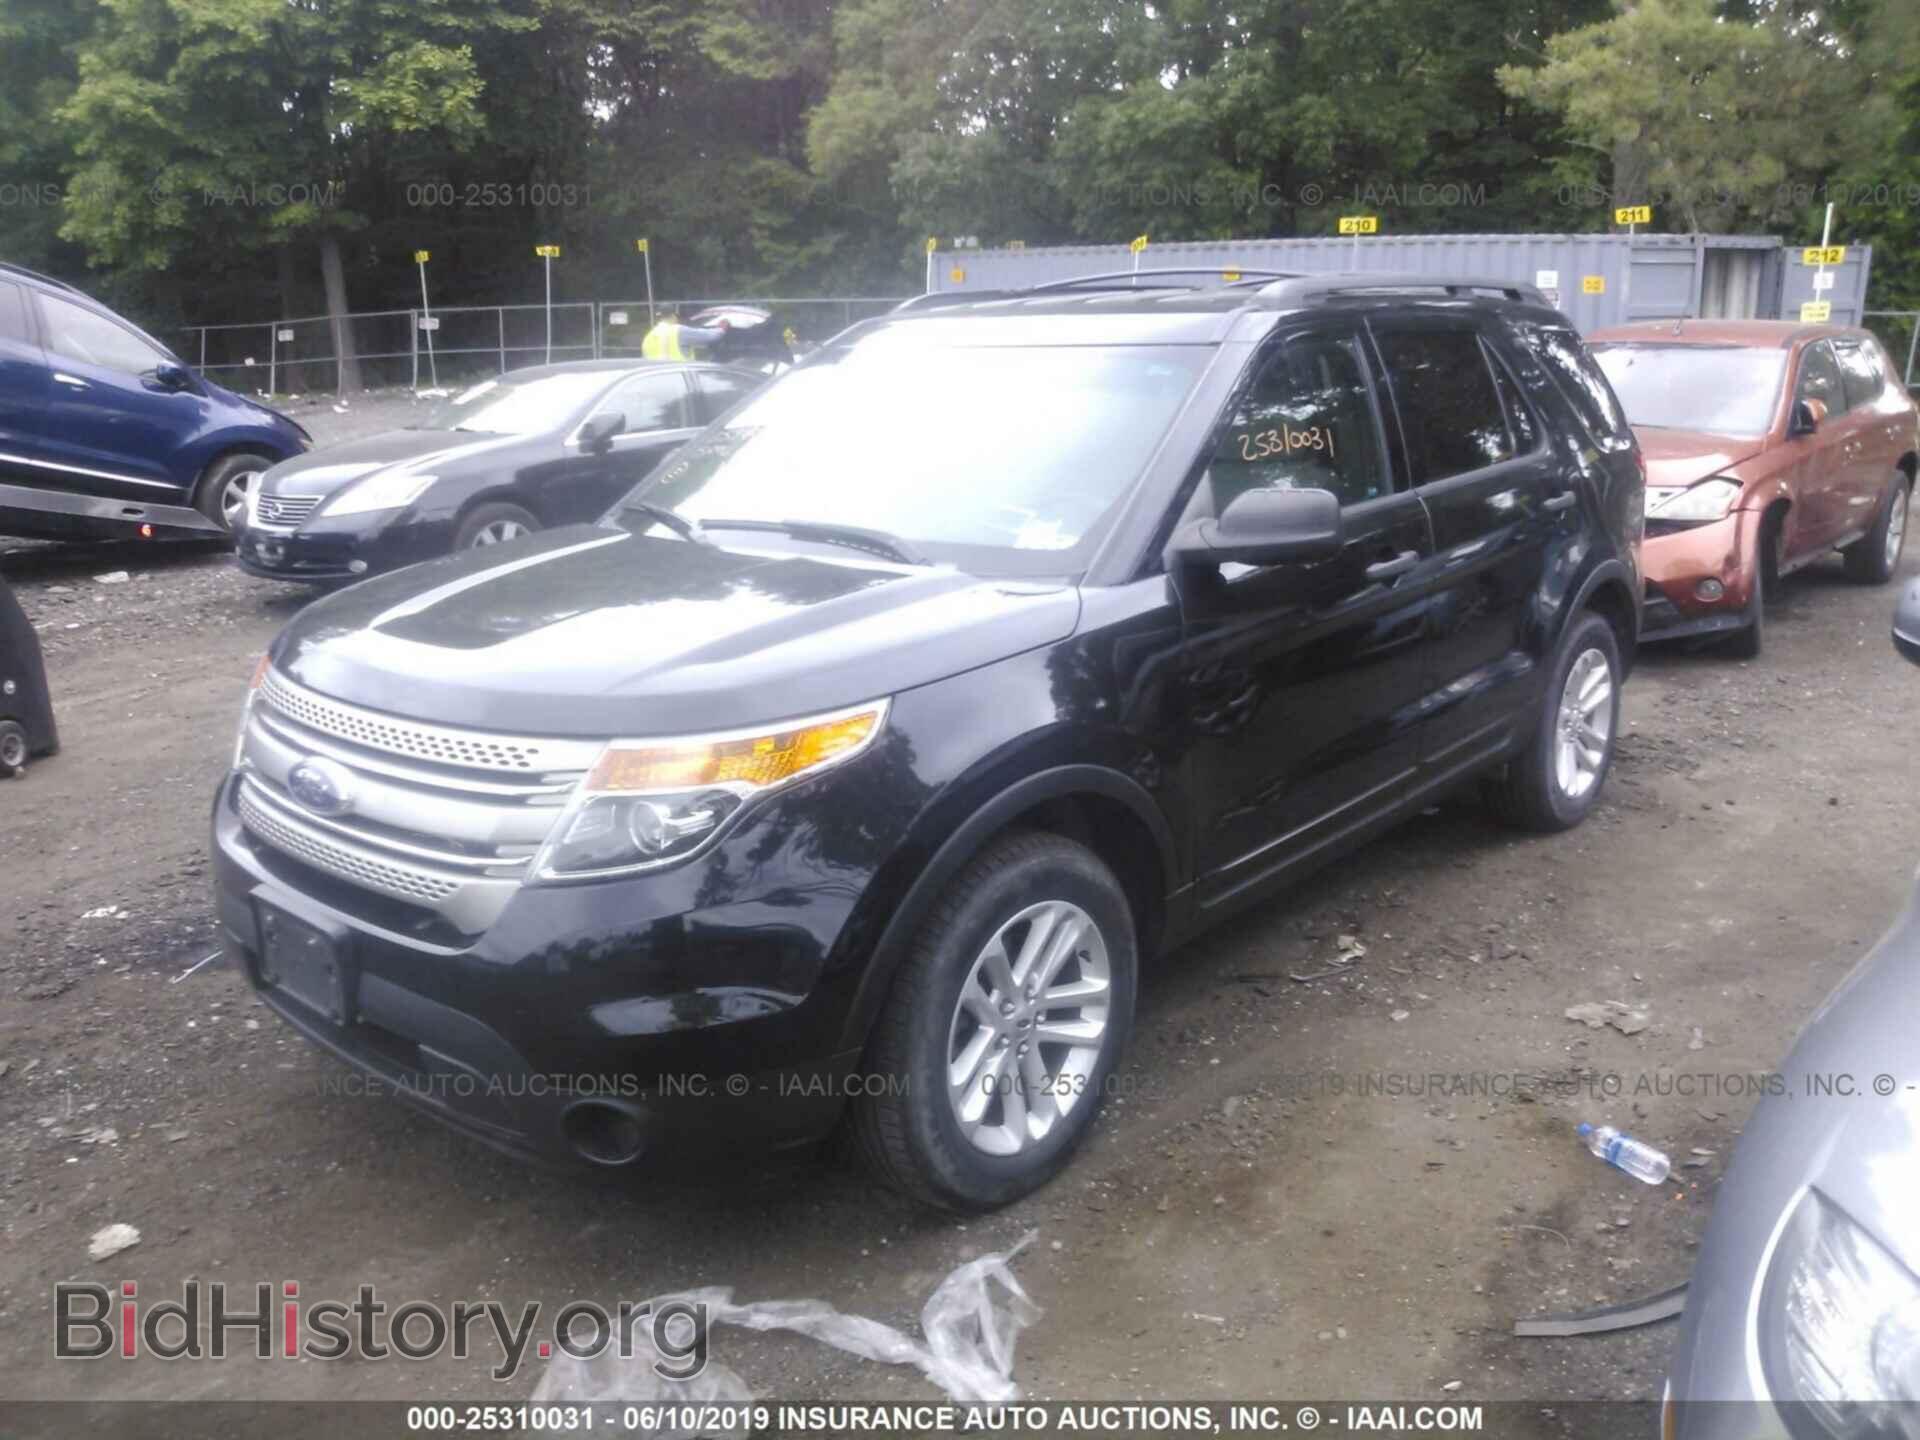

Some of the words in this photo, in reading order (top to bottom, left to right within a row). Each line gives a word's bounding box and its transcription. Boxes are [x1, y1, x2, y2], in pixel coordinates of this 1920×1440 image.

[1620, 208, 1645, 222] 211
[1344, 220, 1371, 232] 210
[1807, 248, 1840, 263] 212
[1238, 423, 1335, 461] 25310031
